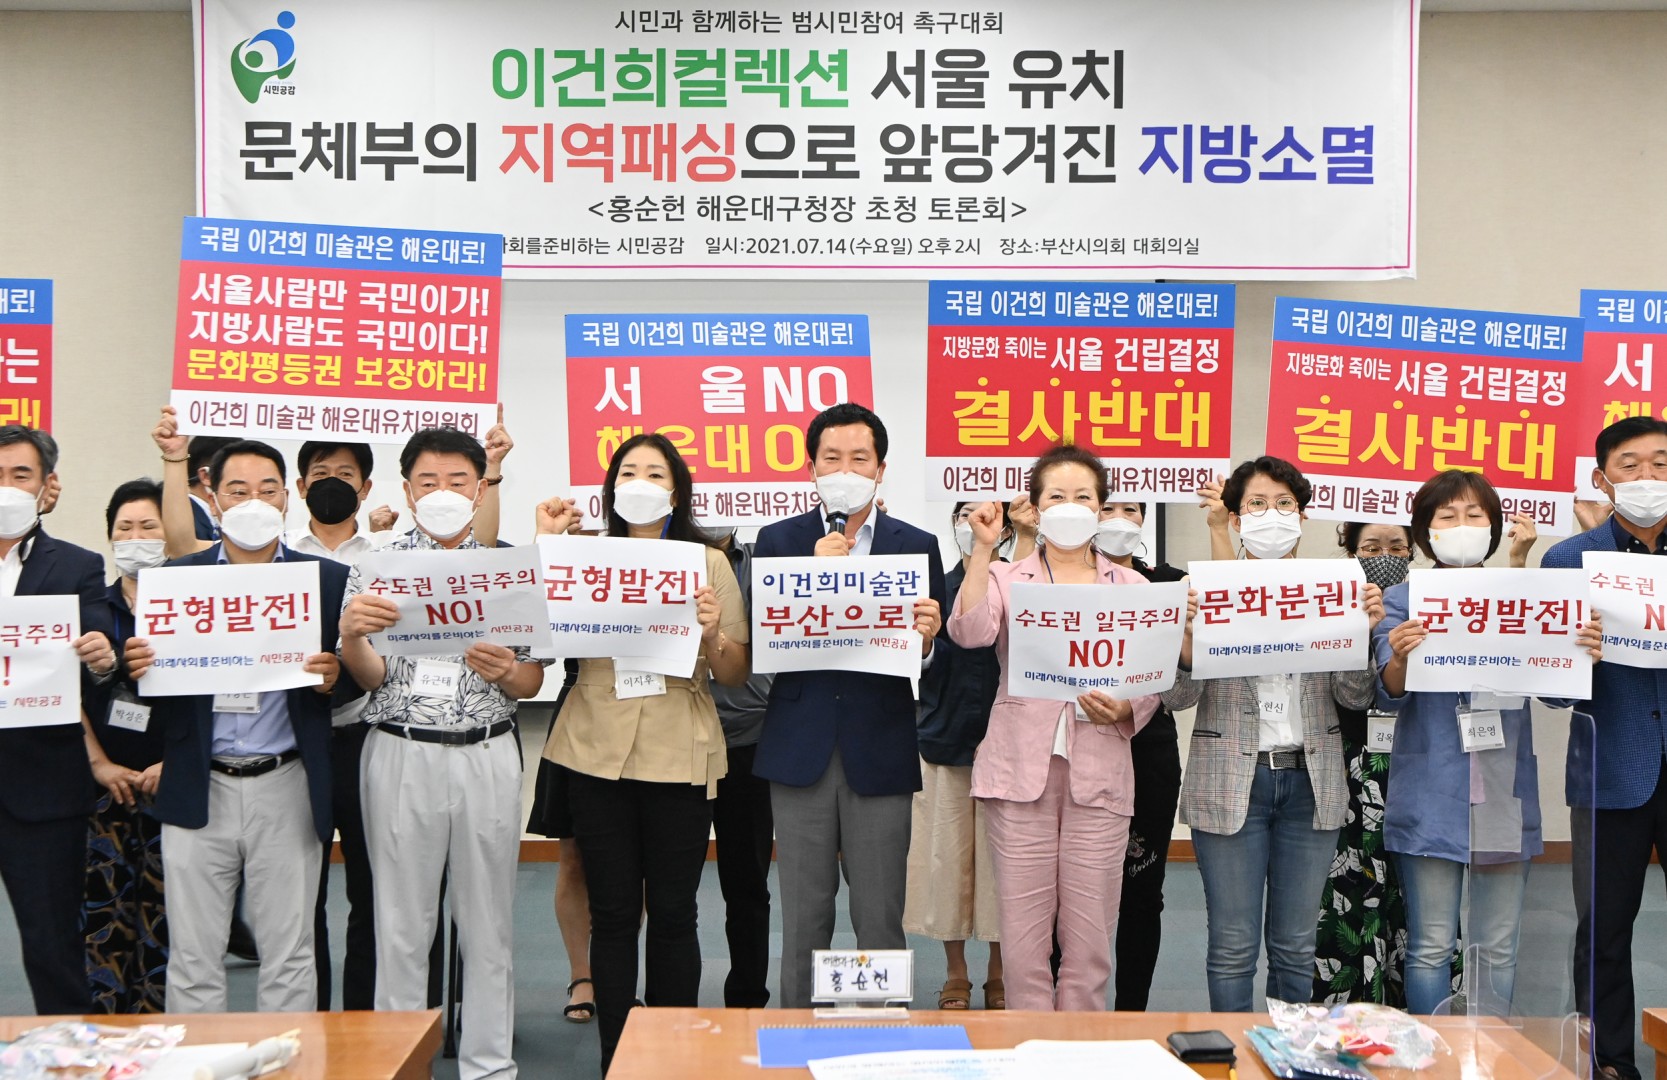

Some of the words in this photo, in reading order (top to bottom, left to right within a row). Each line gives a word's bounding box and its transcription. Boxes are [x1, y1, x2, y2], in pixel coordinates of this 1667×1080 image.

[614, 9, 684, 35] 시민과
[691, 9, 783, 35] 함께하는
[791, 10, 904, 36] 범시민참여
[913, 11, 1004, 36] 촉구대회
[263, 85, 296, 96] 시민공감
[491, 46, 849, 109] 이건희컬렉션
[871, 47, 990, 110] 서울
[1008, 47, 1125, 110] 유치
[238, 121, 478, 183] 문체부의
[498, 122, 861, 184] 지역패싱으로
[879, 122, 1117, 185] 앞당겨진
[1138, 123, 1375, 185] 지방소멸
[588, 194, 686, 223] <홍순헌
[696, 194, 857, 224] 해운대구청장
[865, 195, 918, 224] 초청
[927, 195, 1028, 224] 토론회>
[200, 225, 240, 253] 국립
[248, 228, 307, 257] 이건희
[315, 232, 395, 262] 미술관은
[401, 236, 487, 265] 해운대로!
[502, 236, 611, 255] 회를준비하는
[616, 236, 685, 255] 시민공감
[999, 237, 1127, 256] 장소:부산시의회
[1133, 237, 1200, 256] 대회의실
[190, 272, 349, 311] 서울사람만
[358, 281, 490, 318] 국민이가!
[946, 290, 983, 316] 국립
[991, 290, 1047, 317] 이건희
[1054, 291, 1130, 318] 미술관은
[1137, 292, 1219, 319] 해운대로!
[1597, 297, 1636, 323] 국립
[188, 309, 345, 348] 지방사람도
[356, 318, 489, 355] 국민이다!
[582, 322, 620, 347] 국립
[628, 321, 684, 347] 이건희
[692, 321, 768, 347] 미술관은
[774, 321, 854, 347] 해운대로!
[1291, 307, 1329, 335] 국립
[1336, 309, 1393, 340] 이건희
[1402, 314, 1478, 346] 미술관은
[1484, 320, 1568, 351] 해운대로!
[0, 338, 39, 384] 는
[942, 335, 1000, 360] 지방문화
[1004, 336, 1048, 360] 죽이는
[1050, 336, 1104, 372] 서울
[1114, 337, 1220, 374] 건립결정
[186, 348, 343, 387] 문화평등권
[354, 356, 487, 393] 보장하라!
[1286, 352, 1344, 378] 지방문화
[1348, 356, 1392, 381] 죽이는
[1394, 360, 1449, 397] 서울
[1459, 364, 1568, 407] 건립결정
[189, 400, 248, 428] 이건희
[257, 403, 316, 432] 미술관
[322, 405, 479, 438] 해운대유치위원회
[952, 388, 1212, 448] 결사반대
[1292, 406, 1557, 481] 결사반대
[943, 466, 999, 493] 이건희
[716, 491, 821, 518] 해운대유치
[1343, 487, 1400, 515] 미술관
[368, 576, 432, 597] 수도권
[447, 568, 537, 595] 일극주의
[543, 564, 700, 606] 균형발전!
[761, 570, 922, 599] 이건희미술관
[1590, 572, 1655, 597] 수도권
[144, 591, 310, 636] 균형발전!
[426, 599, 486, 627] NO!
[1199, 579, 1359, 625] 문화분권!
[1417, 596, 1584, 635] 균형발전!
[387, 628, 485, 643] 미래사회를준비하는
[490, 623, 534, 635] 시민공감
[549, 622, 643, 635] 미래사회를준비하는
[647, 624, 691, 637] 시민공감
[1014, 607, 1082, 633] 수도권
[1095, 606, 1181, 633] 일극주의
[768, 637, 864, 651] 미래사회를준비하는
[869, 637, 909, 650] 시민공감
[1068, 638, 1126, 669] NO!
[1208, 640, 1305, 657] 미래사회를준비하는
[1310, 638, 1353, 652] 시민공감
[153, 655, 255, 669] 미래사회를준비하는
[259, 652, 305, 665] 시민공감
[1424, 654, 1522, 669] 미래사회를준비하는
[1527, 655, 1574, 669] 시민공감
[1024, 670, 1120, 688] 미래사회를준비하는
[1124, 670, 1163, 685] 시민공감
[14, 695, 62, 708] 시민공감
